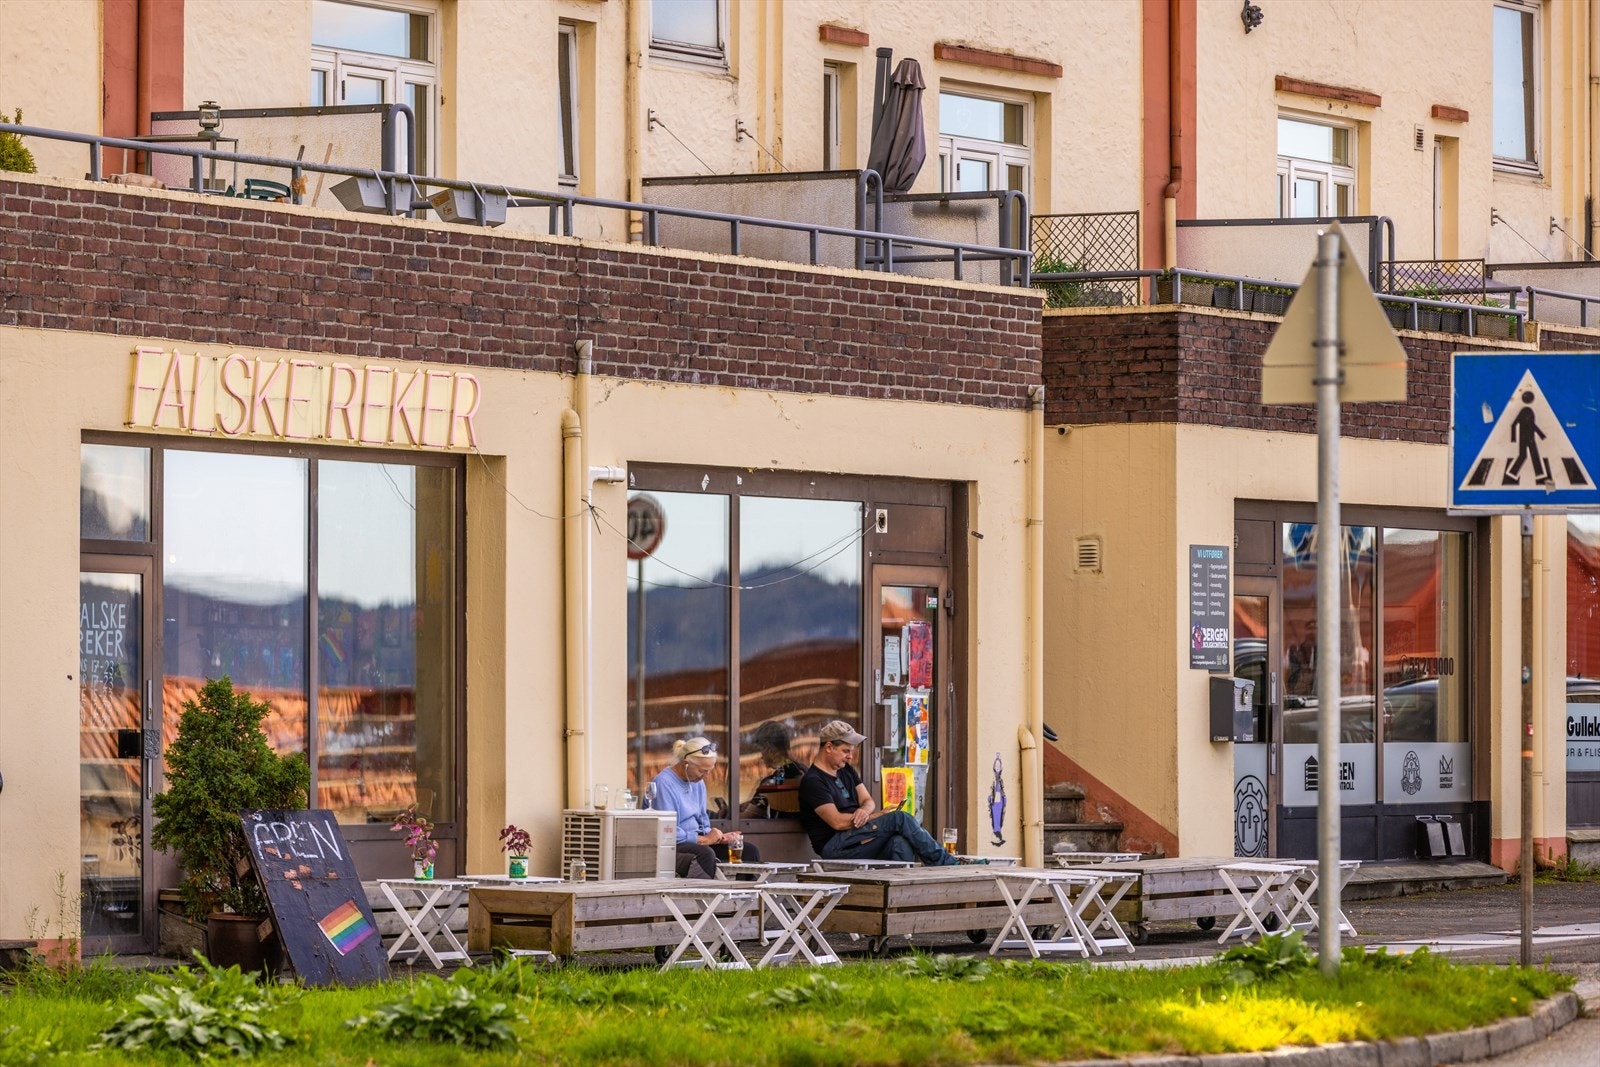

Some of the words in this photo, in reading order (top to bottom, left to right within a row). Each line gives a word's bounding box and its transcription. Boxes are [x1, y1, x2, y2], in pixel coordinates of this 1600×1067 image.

[127, 345, 317, 440] FALSKE
[325, 362, 482, 449] REKER
[80, 600, 126, 630] ALSKE
[1433, 657, 1454, 676] 9000
[1577, 748, 1583, 758] &
